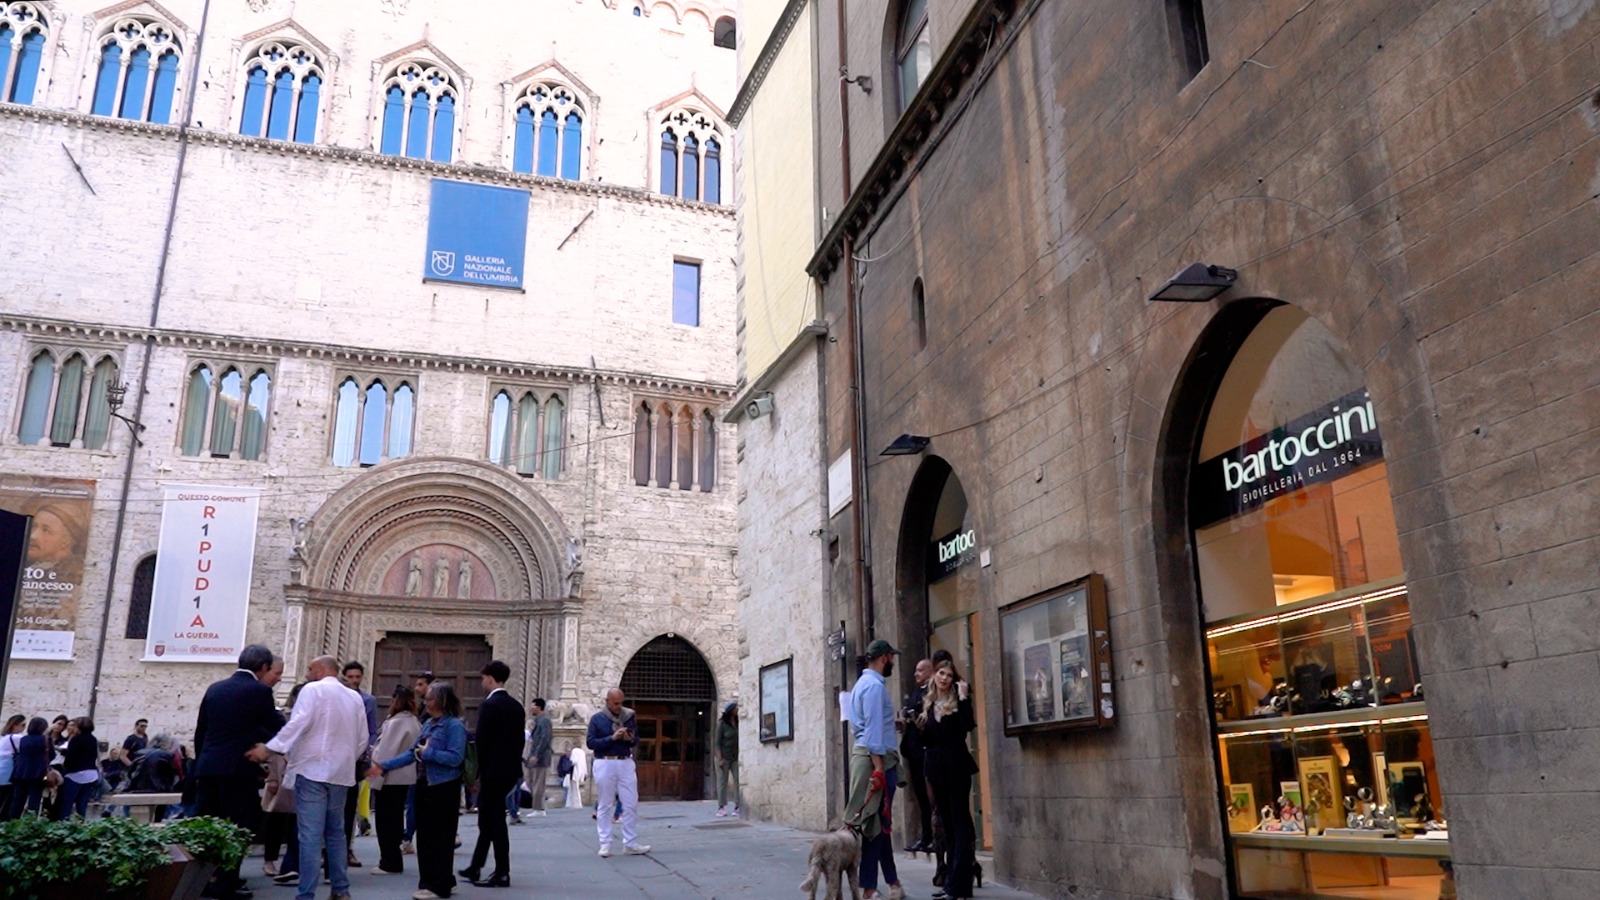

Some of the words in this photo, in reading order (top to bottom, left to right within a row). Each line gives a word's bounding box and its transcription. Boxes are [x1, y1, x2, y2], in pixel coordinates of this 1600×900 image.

[464, 254, 505, 265] GALLERIA
[464, 263, 512, 275] NAZIONALE
[463, 271, 519, 283] DELL'UMBRIA
[1222, 392, 1377, 491] bartoccini
[1242, 472, 1304, 503] GIOIELLERIA
[1308, 462, 1328, 477] DAL
[1333, 448, 1362, 468] 1964
[178, 493, 209, 502] QUESTO
[211, 495, 247, 503] COMUNE
[23, 566, 45, 580] to
[48, 571, 57, 580] e
[35, 616, 69, 626] Giugno
[186, 632, 220, 640] GUERRA
